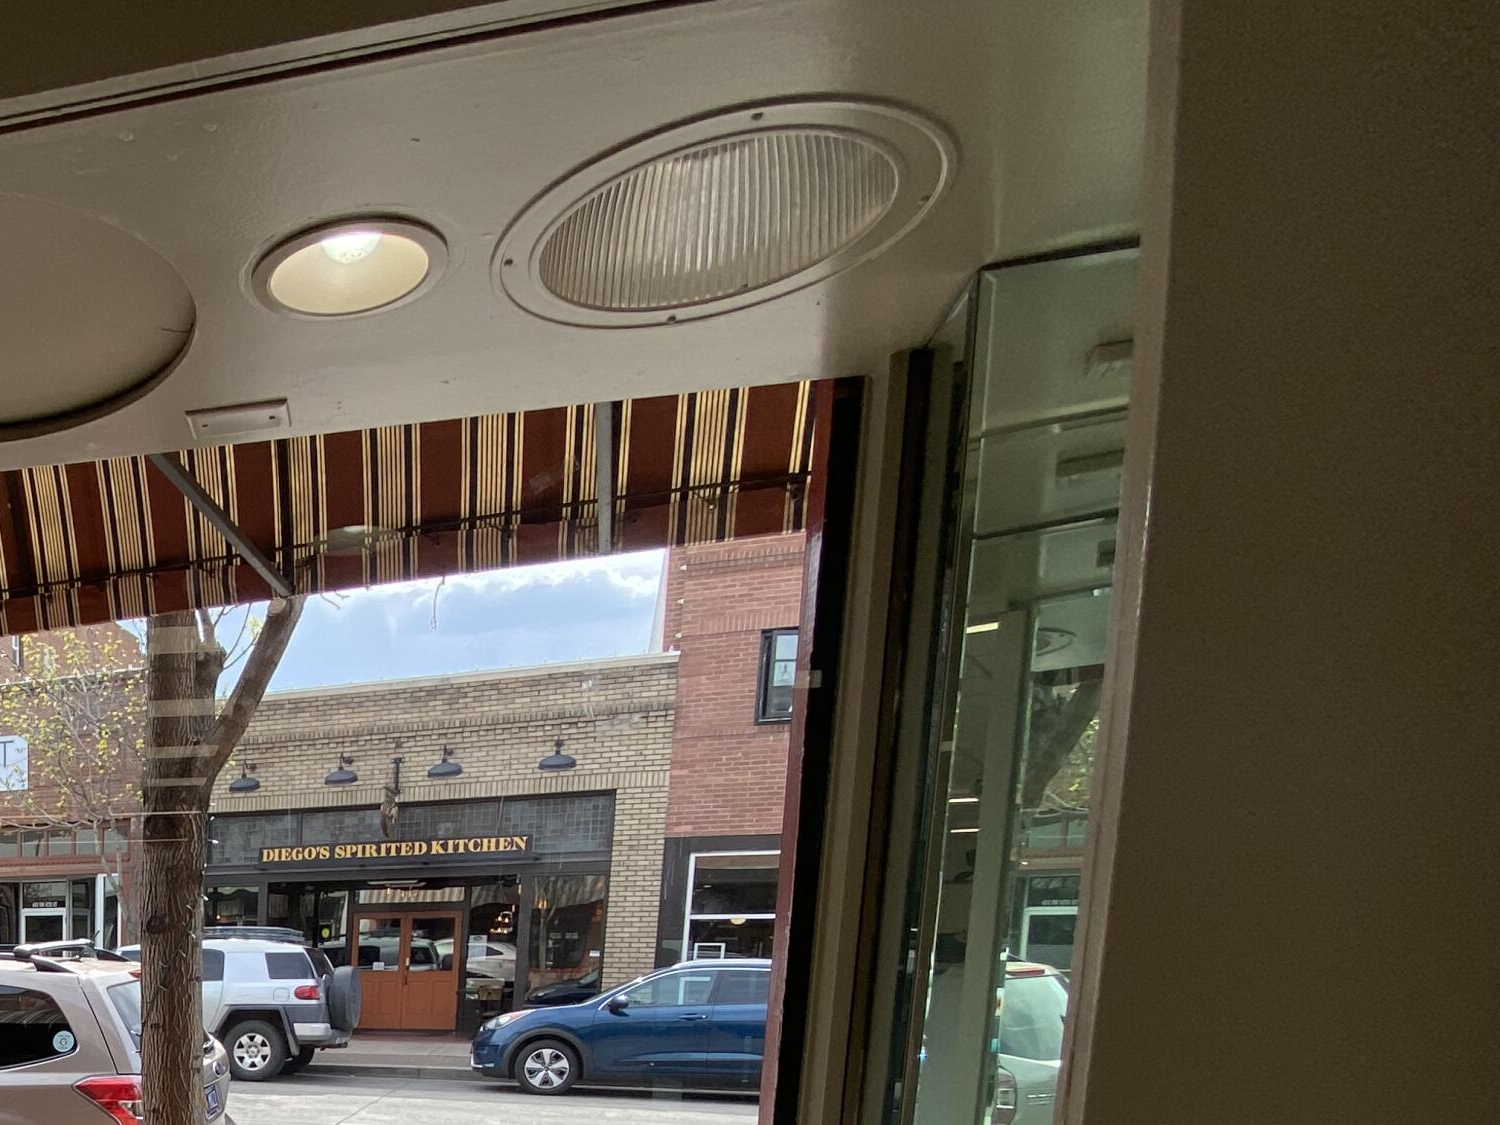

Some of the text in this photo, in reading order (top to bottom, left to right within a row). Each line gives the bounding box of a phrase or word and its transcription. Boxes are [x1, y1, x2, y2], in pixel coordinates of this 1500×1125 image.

[262, 836, 529, 863] DIEGO'S SPIRITED KITCHEN
